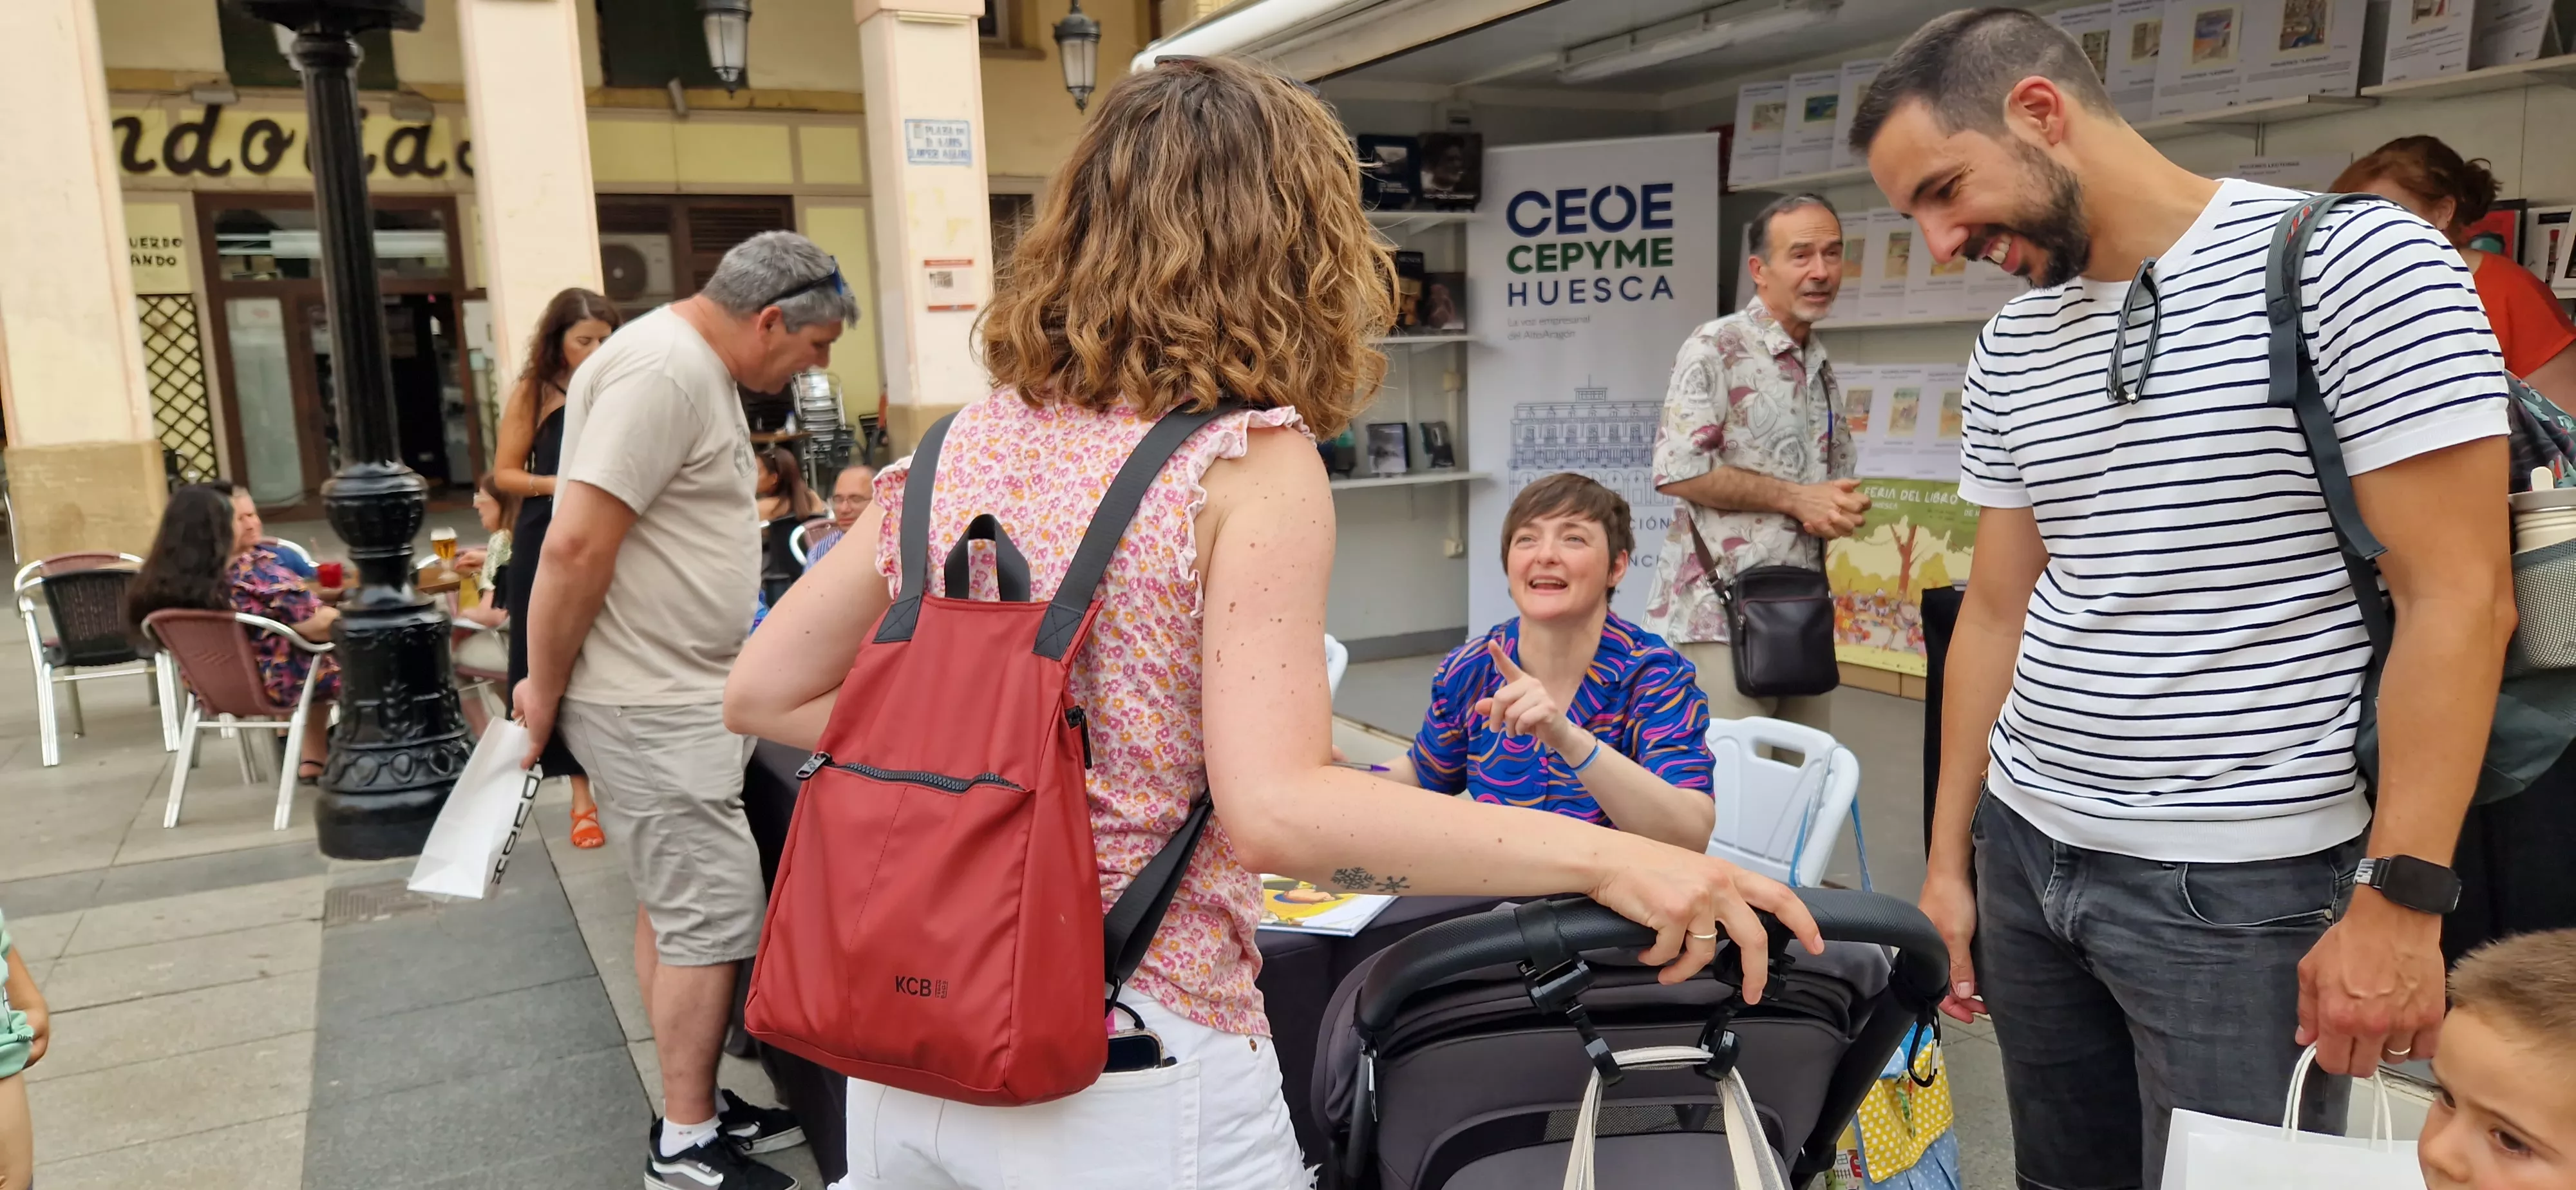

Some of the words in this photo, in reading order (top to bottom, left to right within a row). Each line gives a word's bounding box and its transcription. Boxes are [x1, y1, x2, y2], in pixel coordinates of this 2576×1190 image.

[1506, 183, 1673, 238] CEOE
[1506, 237, 1673, 275] CEPYME
[1508, 275, 1674, 307] HUESCA
[1864, 487, 1896, 499] FERIA
[1900, 489, 1921, 503] DEL
[1924, 491, 1958, 505] LIBRO
[895, 975, 932, 997] KCB
